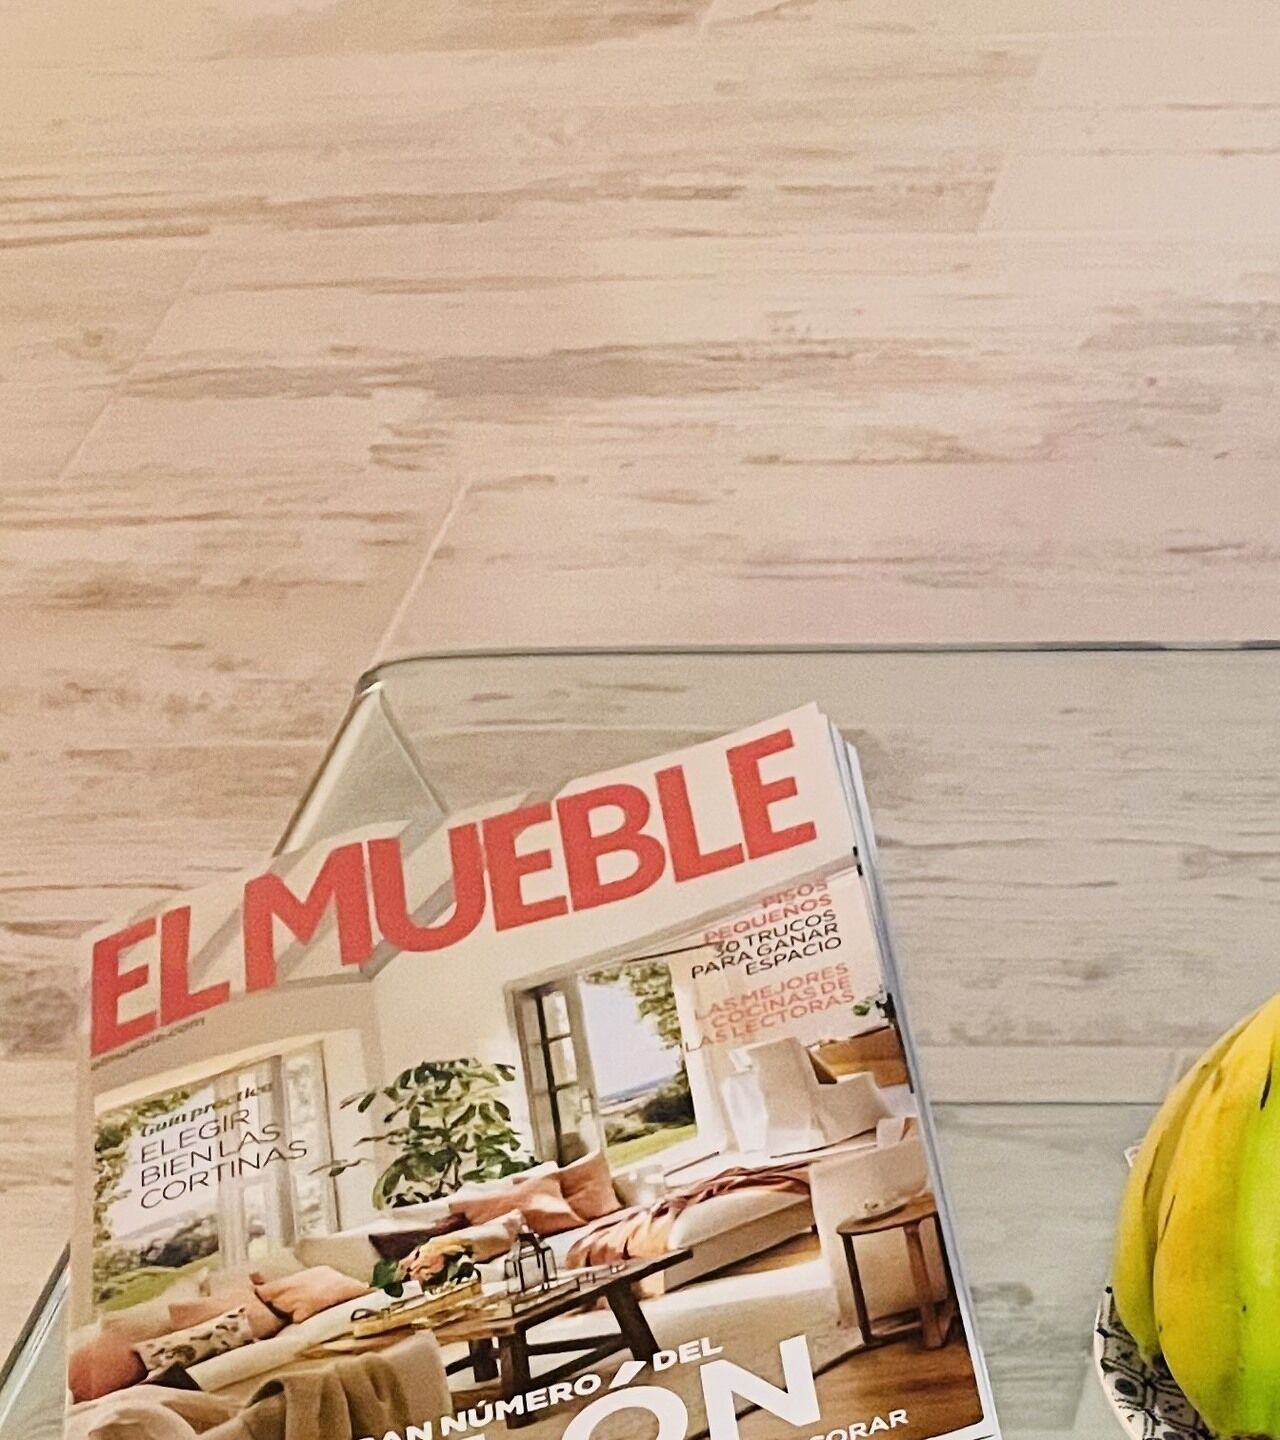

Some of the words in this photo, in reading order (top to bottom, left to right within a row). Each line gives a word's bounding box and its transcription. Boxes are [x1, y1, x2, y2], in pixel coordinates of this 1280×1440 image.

[90, 906, 231, 1058] EL
[243, 728, 818, 992] MUEBLE
[759, 878, 829, 909] PISOS
[690, 950, 753, 979] PARA
[756, 922, 839, 958] GANAR
[714, 939, 741, 958] 30
[744, 909, 837, 947] TRUCOS
[745, 936, 842, 976] ESPACIO
[711, 983, 818, 1030] COCINAS
[820, 976, 853, 996] DE
[740, 962, 850, 1008] MEJORES
[732, 991, 856, 1039] LECTORAS
[140, 1109, 251, 1164] ELEGIR
[141, 1145, 213, 1188] BIEN
[219, 1122, 281, 1158] LAS
[140, 1139, 308, 1209] CORTINAS
[439, 1372, 603, 1438] NÚMERO
[651, 1335, 725, 1372] DEL
